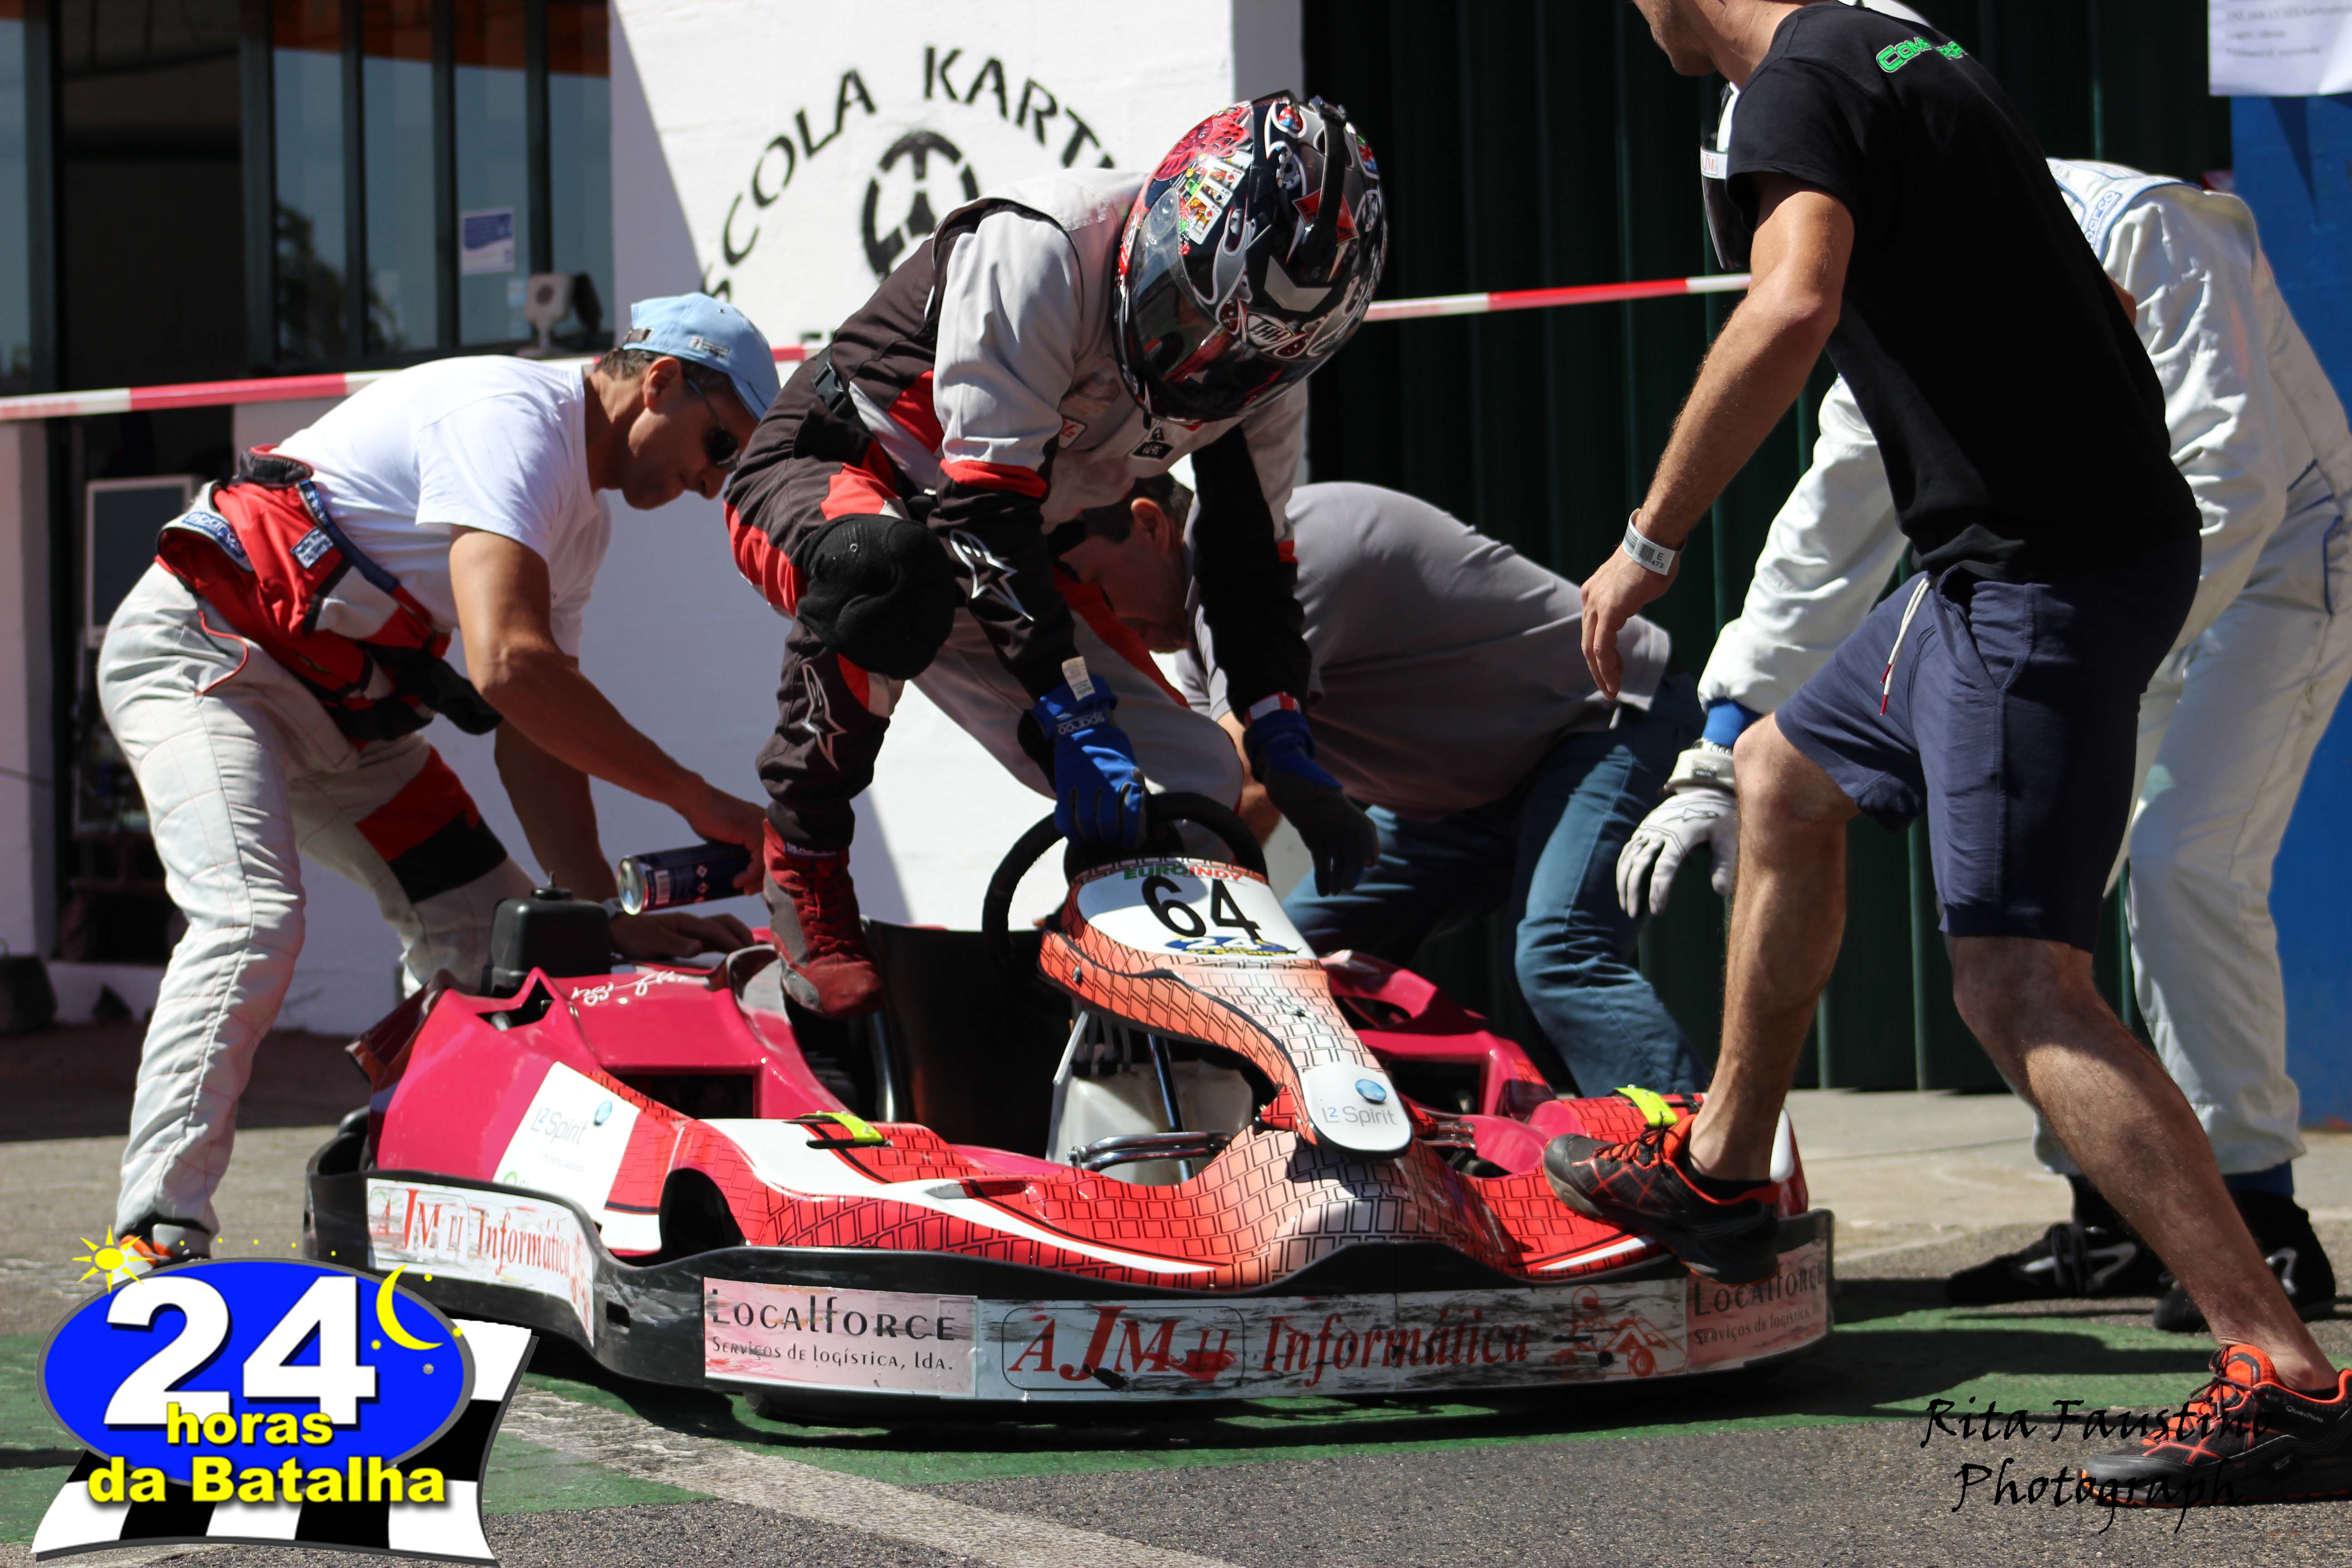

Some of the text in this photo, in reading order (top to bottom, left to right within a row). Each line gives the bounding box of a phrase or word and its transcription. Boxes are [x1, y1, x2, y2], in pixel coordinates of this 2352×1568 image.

[924, 46, 1114, 168] KART
[2085, 190, 2122, 245] parco
[1142, 875, 1262, 941] 64
[1181, 937, 1261, 950] 24
[545, 1111, 588, 1145] Spirit
[1342, 1106, 1398, 1127] Spirit
[468, 1203, 570, 1276] Informática
[1007, 1305, 1180, 1381] AJM
[1258, 1308, 1530, 1388] Informática
[2285, 1405, 2323, 1422] Quechua
